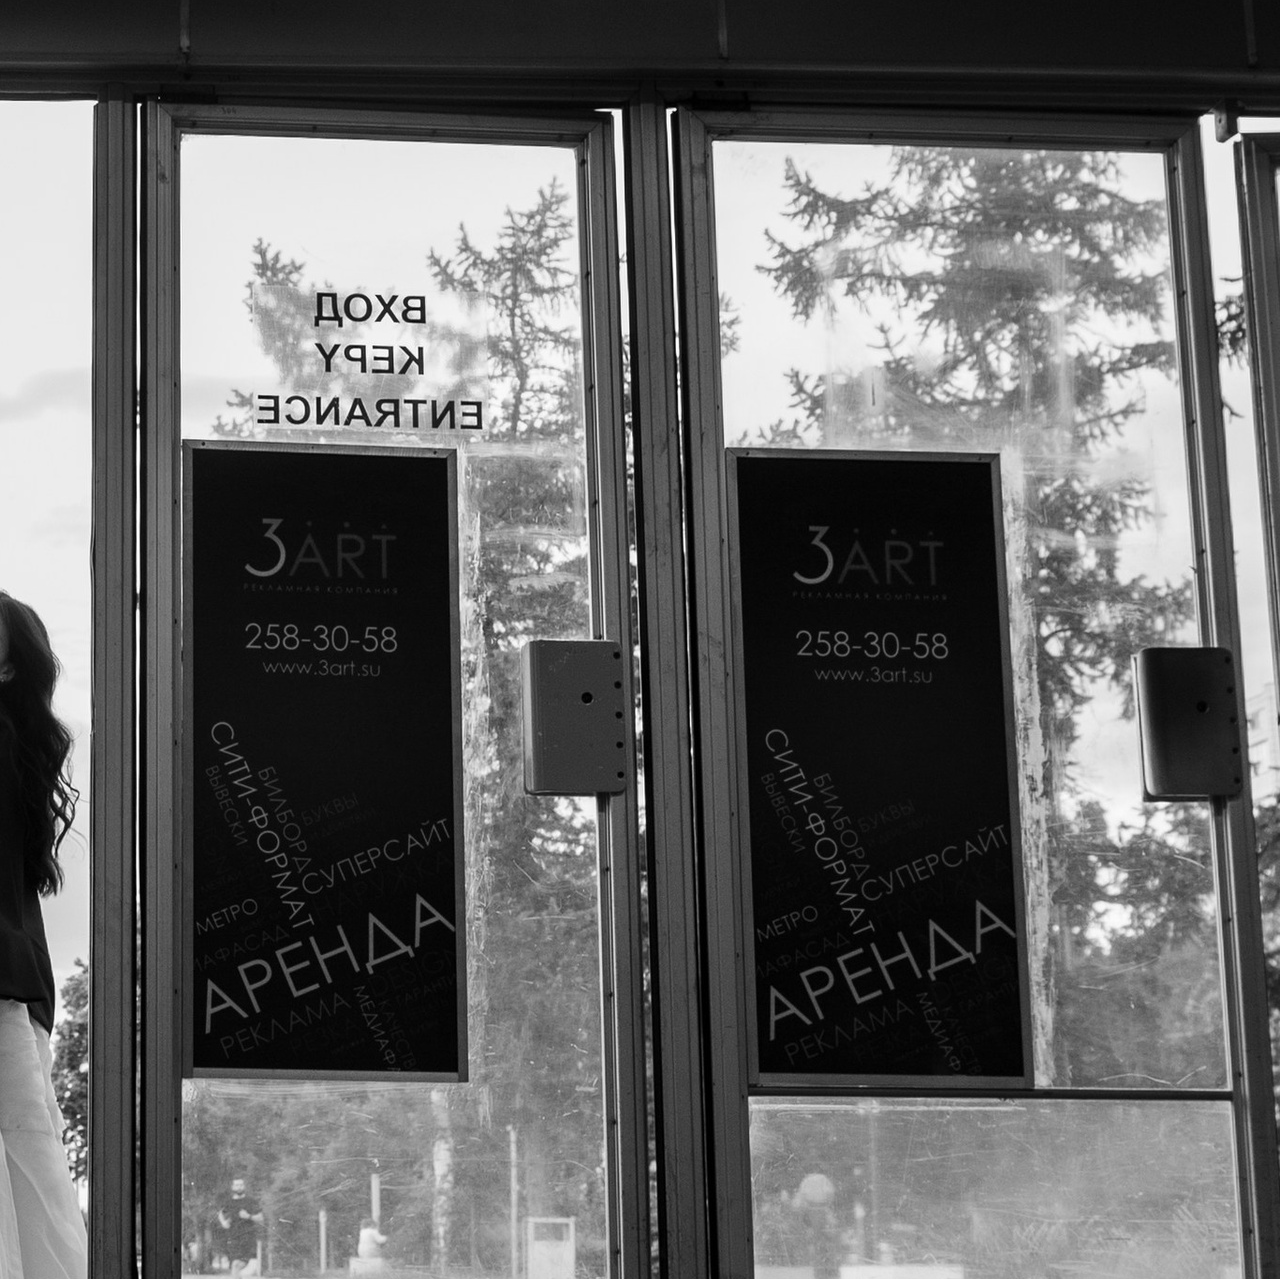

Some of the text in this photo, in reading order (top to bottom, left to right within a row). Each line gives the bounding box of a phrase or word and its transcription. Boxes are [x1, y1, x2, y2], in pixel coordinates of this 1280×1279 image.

[243, 517, 397, 579] 3ART
[792, 525, 944, 586] 3ART
[243, 621, 399, 654] 258-30-58
[261, 658, 382, 677] www.3art.su
[794, 629, 950, 660] 258-30-58
[813, 665, 934, 684] www.3art.su
[210, 720, 316, 930] СИТИ-ФОРМАТ
[301, 817, 451, 895] СУПЕРСАЙТ
[764, 728, 876, 936] СИТИ-ФОРМАТ
[861, 824, 1009, 902] СУПЕРСАЙТ
[195, 897, 259, 936] МЕТРО
[756, 905, 818, 943] МЕТРО
[204, 892, 456, 1035] АРЕНДА
[768, 899, 1017, 1042] АРЕНДА
[220, 991, 352, 1059] РЕКЛАМА
[784, 998, 915, 1066] РЕКЛАМА
